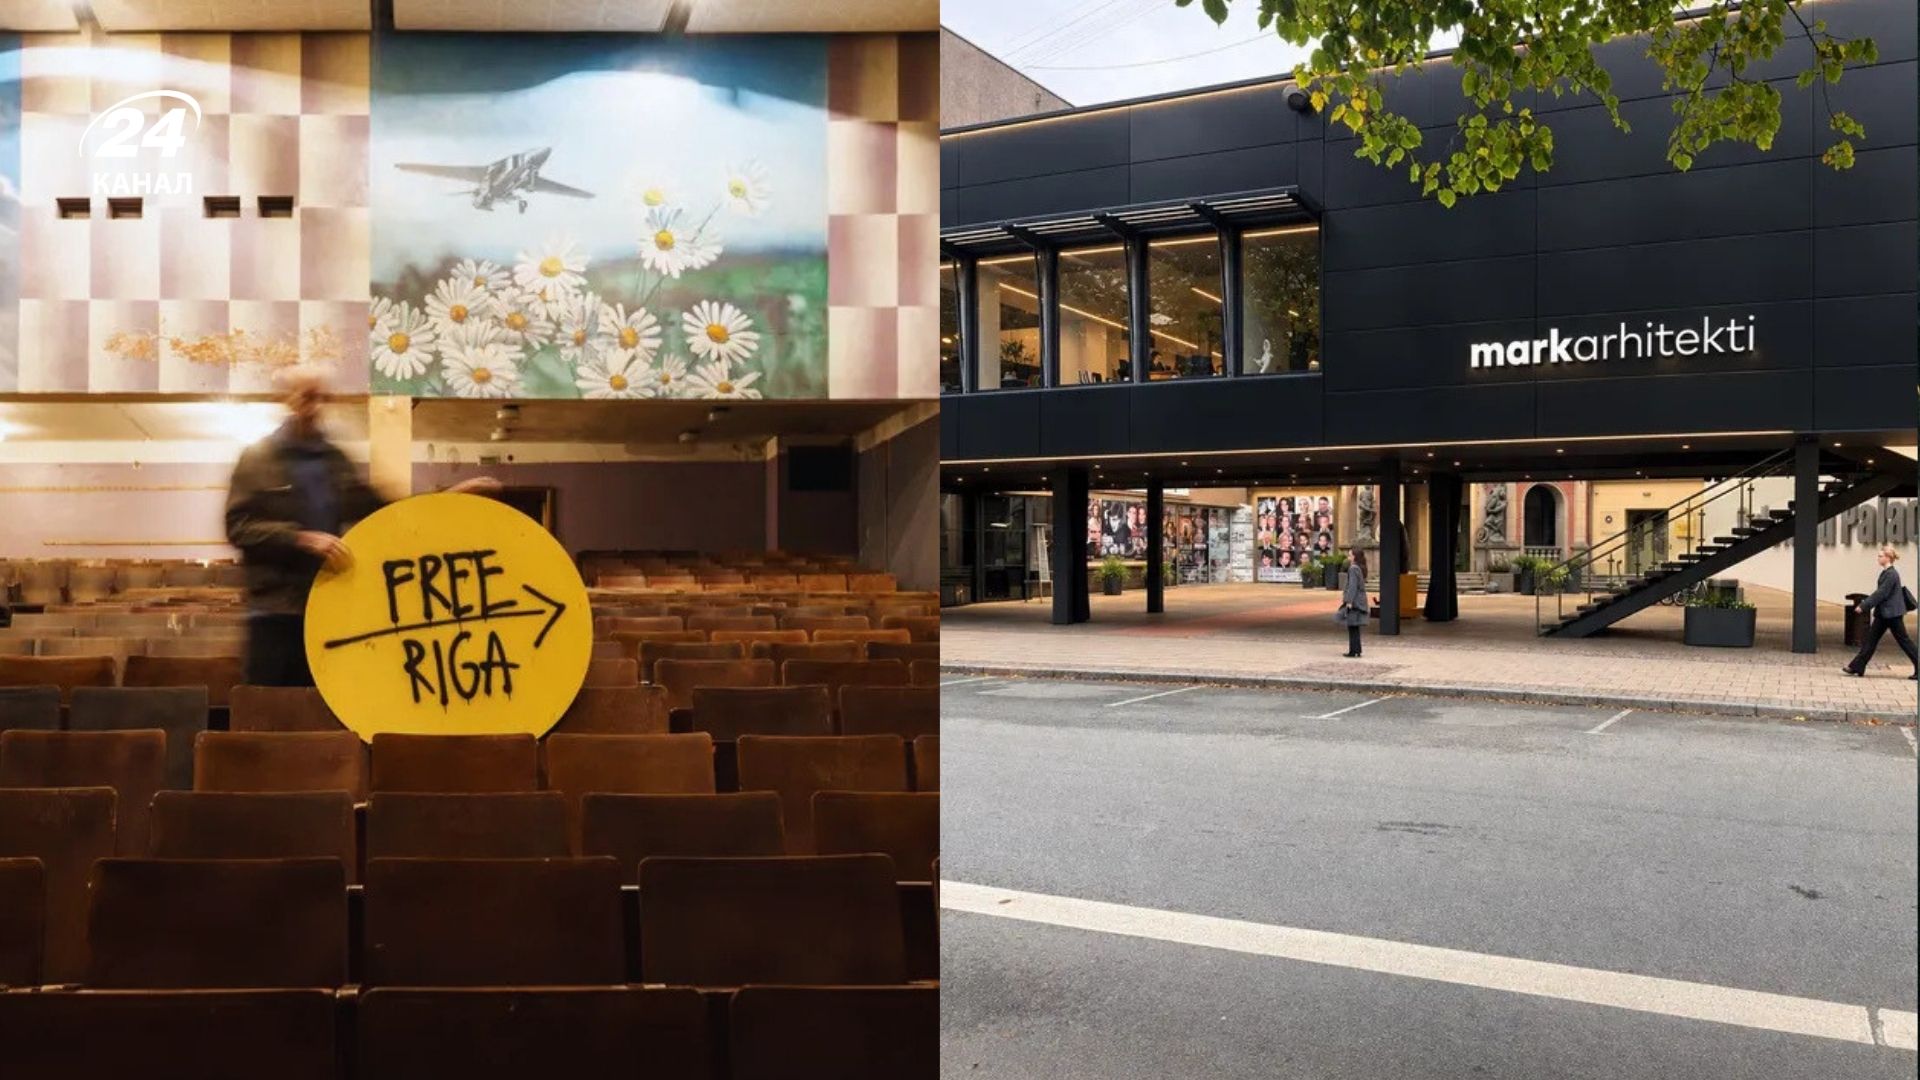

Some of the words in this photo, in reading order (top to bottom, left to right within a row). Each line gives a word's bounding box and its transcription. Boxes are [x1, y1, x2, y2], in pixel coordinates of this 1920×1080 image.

[1470, 314, 1756, 368] markarhitekti
[382, 549, 517, 624] FREE
[402, 630, 520, 708] RIGA
